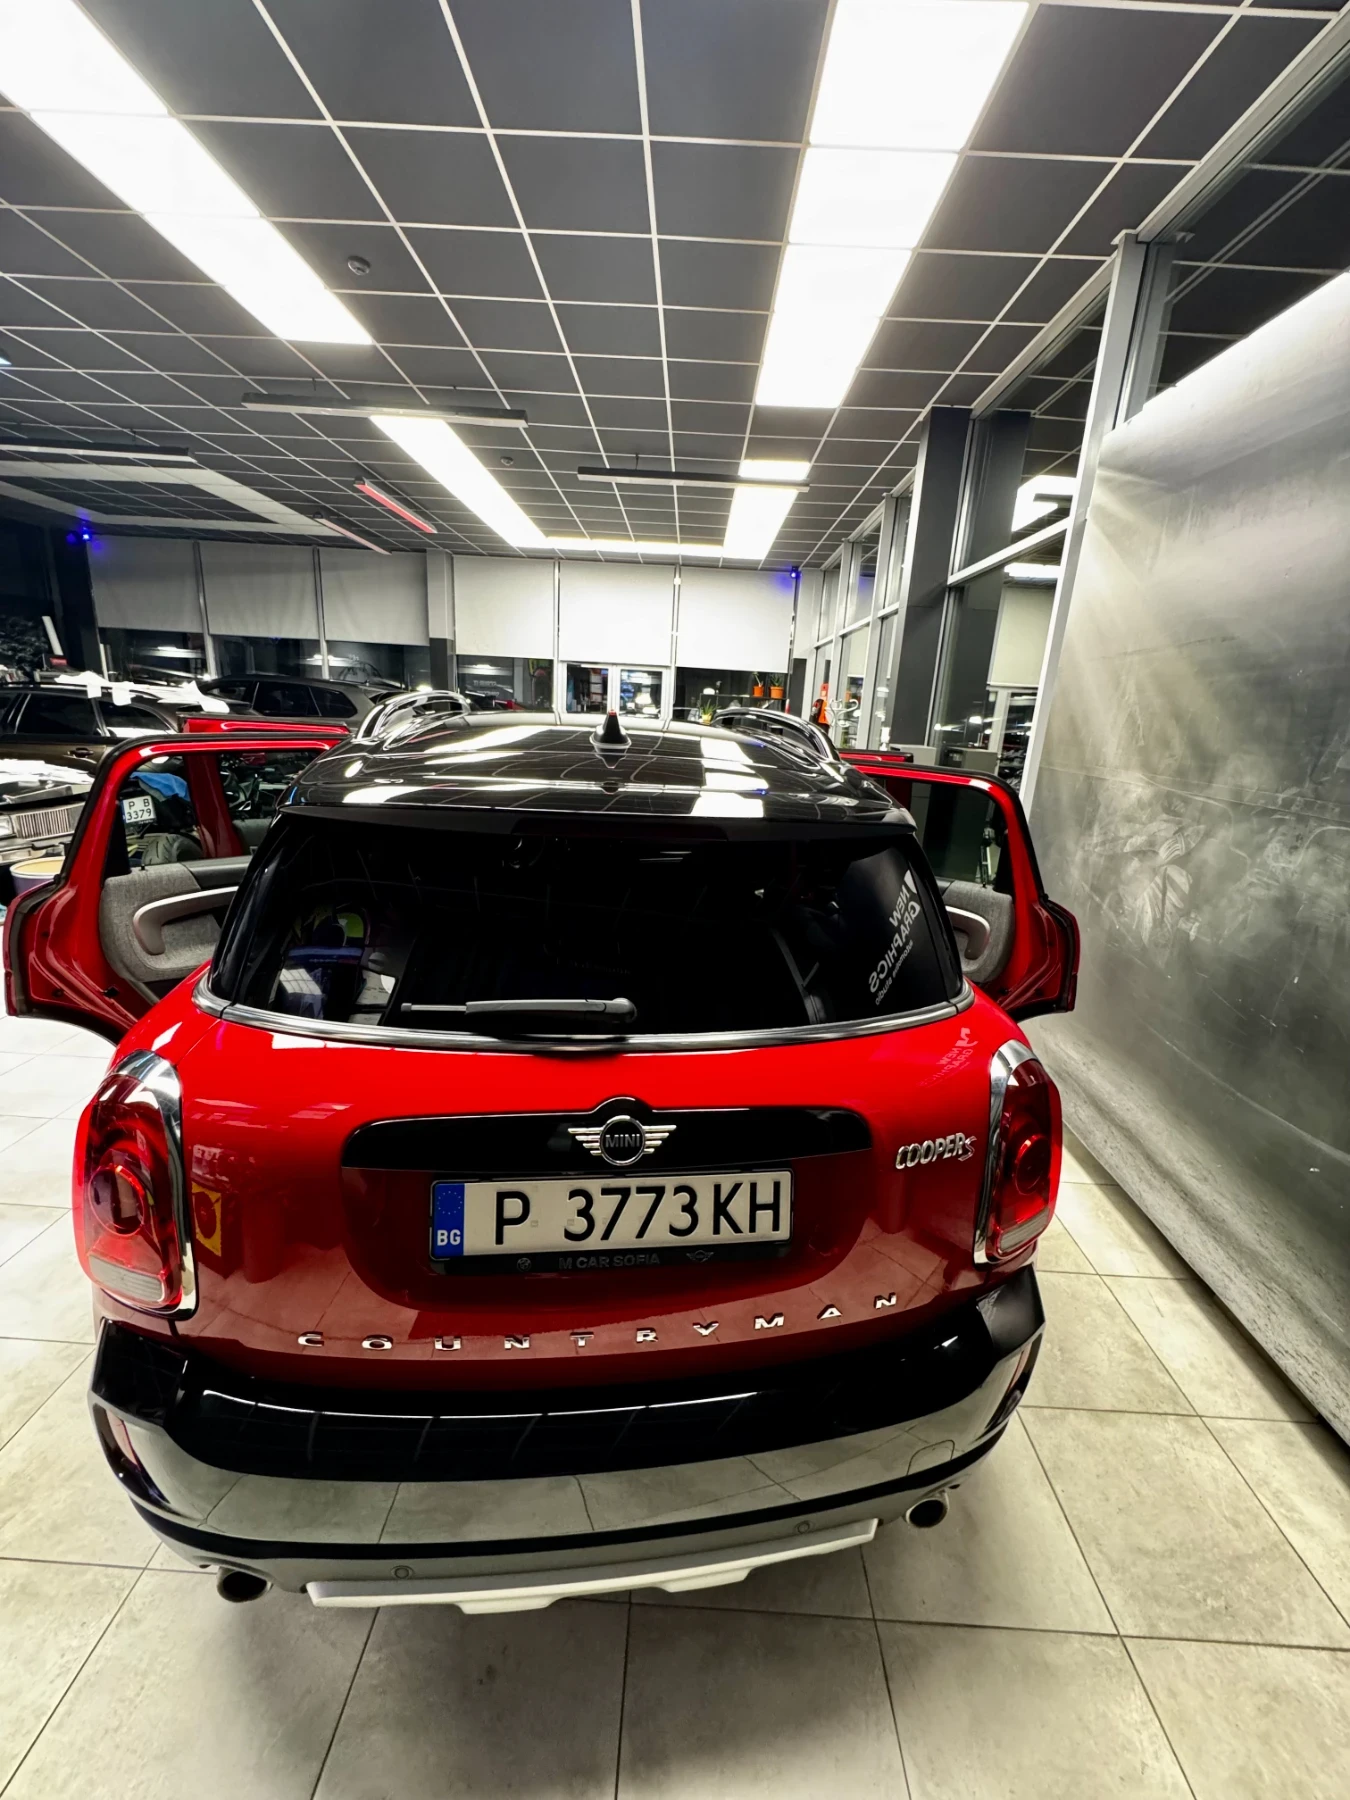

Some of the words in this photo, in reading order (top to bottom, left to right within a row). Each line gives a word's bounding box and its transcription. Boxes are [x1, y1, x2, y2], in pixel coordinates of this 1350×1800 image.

[128, 801, 135, 810] P
[143, 798, 150, 807] B
[126, 808, 152, 820] 3379
[605, 1133, 640, 1149] MINI
[895, 1132, 966, 1170] COOPER
[495, 1190, 531, 1245] P
[436, 1229, 461, 1246] BG
[559, 1257, 573, 1269] M
[576, 1255, 610, 1269] CAR
[613, 1252, 660, 1267] SOFIA
[297, 1291, 898, 1352] COUNTRYMAN
